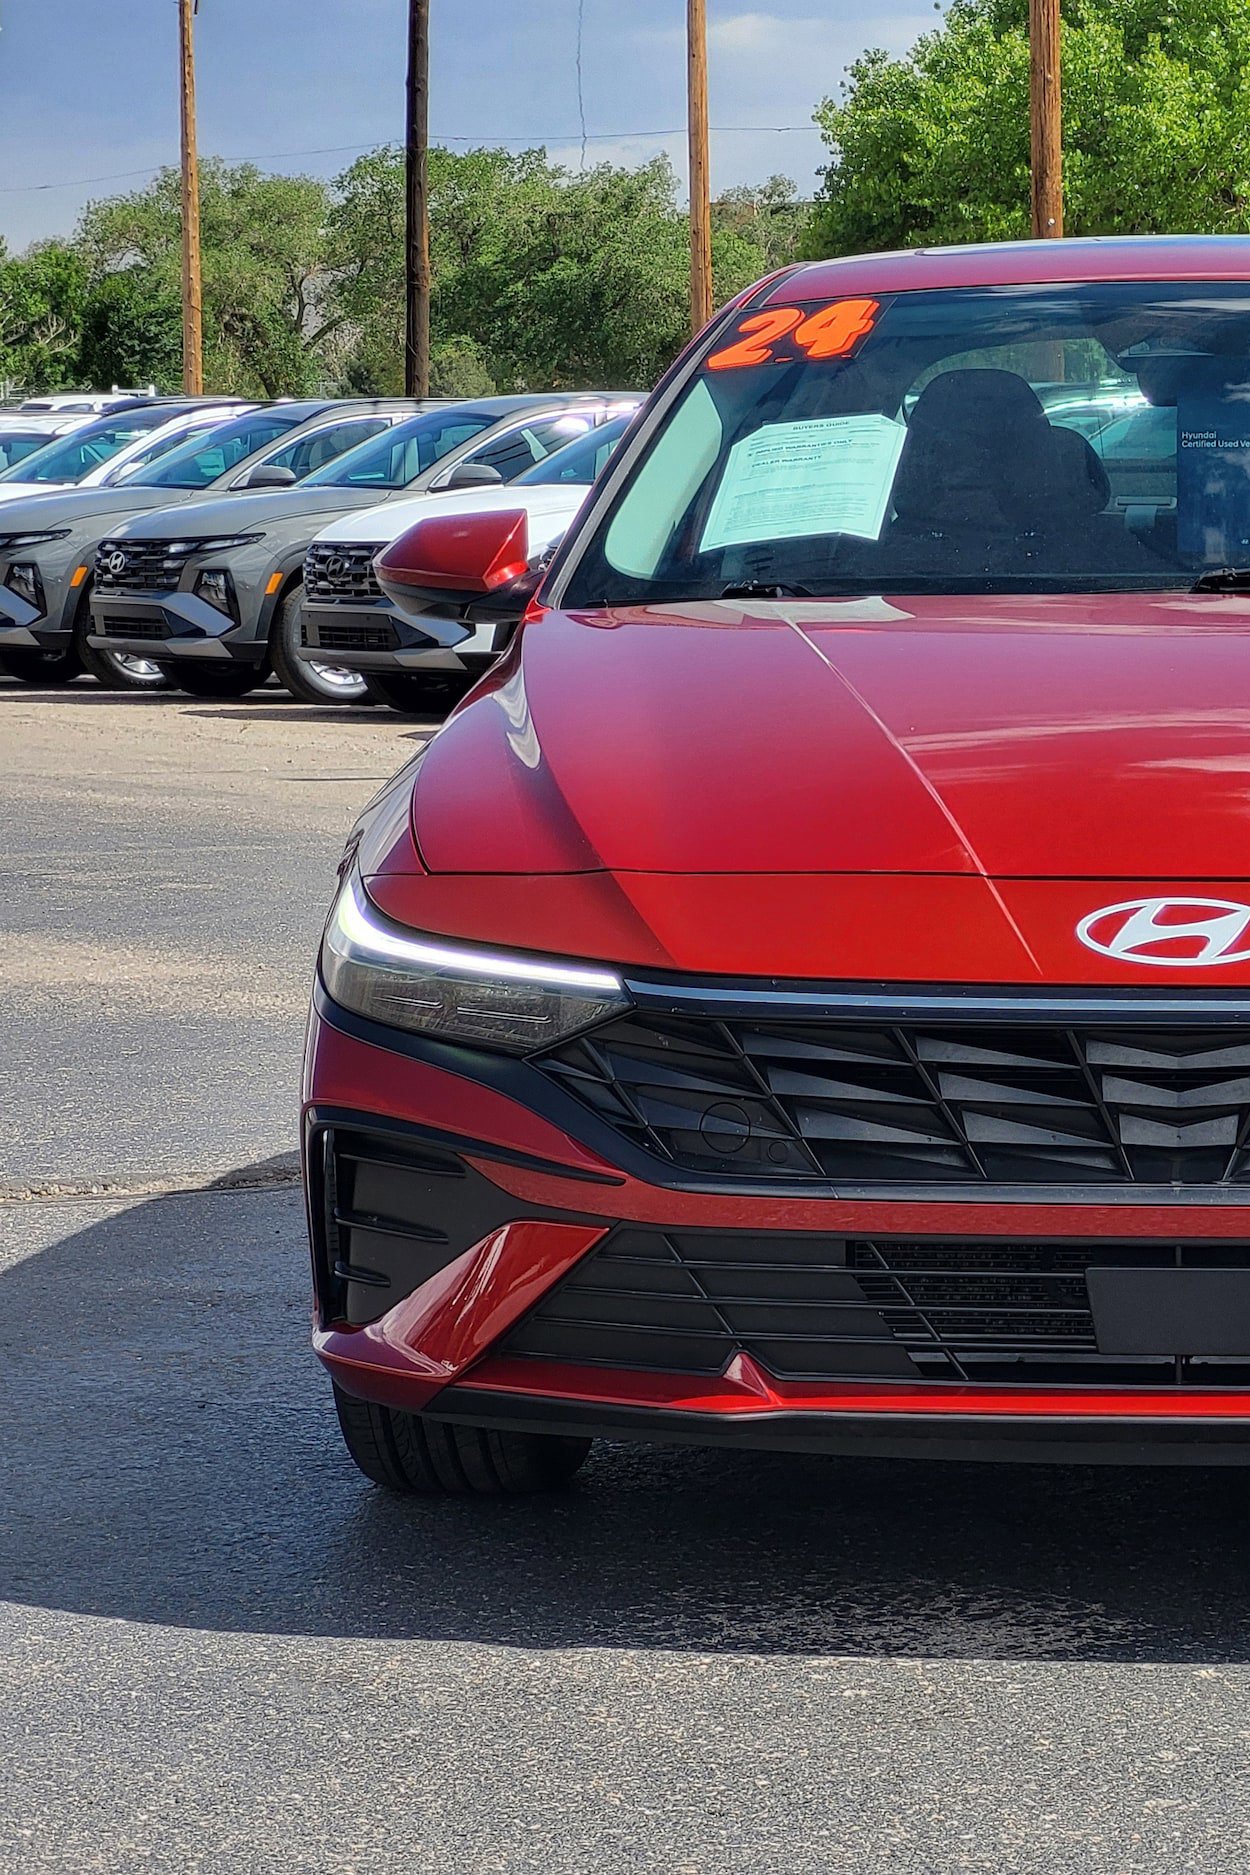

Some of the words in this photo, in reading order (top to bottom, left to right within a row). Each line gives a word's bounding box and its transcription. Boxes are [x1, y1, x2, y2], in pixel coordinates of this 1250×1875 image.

[707, 299, 880, 370] 24
[1181, 431, 1217, 440] Hyundai
[1181, 440, 1217, 448] Certified
[1218, 440, 1239, 448] Used
